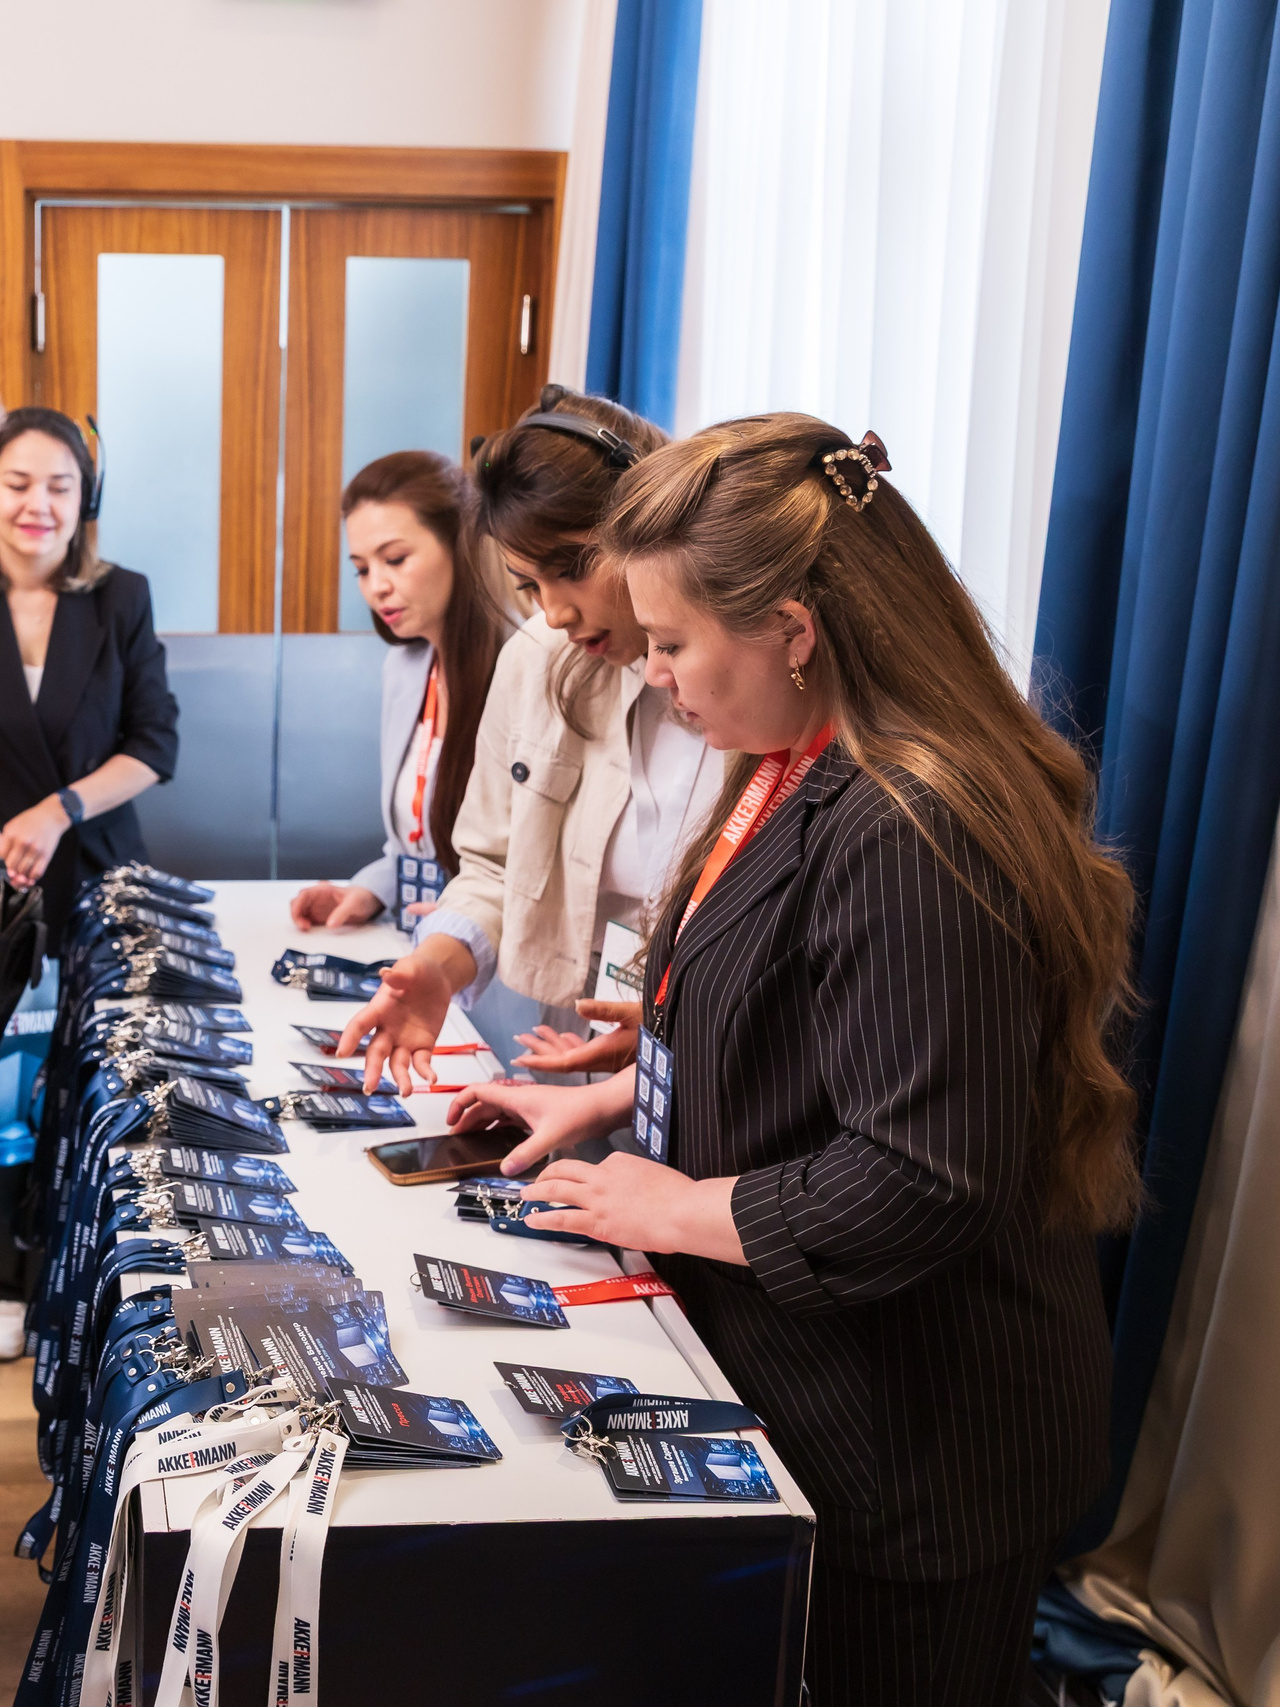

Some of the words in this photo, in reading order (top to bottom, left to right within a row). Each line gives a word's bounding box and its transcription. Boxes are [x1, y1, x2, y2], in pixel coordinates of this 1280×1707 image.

[722, 757, 783, 845] AKKERMANN
[4, 1009, 58, 1037] ERMANN
[208, 1327, 234, 1374] KKERMANN
[261, 1338, 297, 1384] KERMANN
[291, 1321, 316, 1355] Баходир
[311, 1355, 328, 1377] едов
[135, 1402, 171, 1428] RMANN
[392, 1403, 410, 1427] Пресса
[607, 1410, 689, 1430] AKKERMANN
[104, 1428, 124, 1497] AKKERMANN
[157, 1441, 238, 1474] AKKERMANN
[306, 1447, 337, 1516] AKKERMANN
[222, 1480, 276, 1531] AKKERMANN
[83, 1542, 103, 1604] AKKERMANN
[28, 1630, 54, 1684] AKKERMANN
[195, 1628, 213, 1707] KKERMANN
[293, 1617, 311, 1694] AKKERMANN
[117, 1660, 133, 1707] RMANN
[276, 1660, 289, 1707] RMANN
